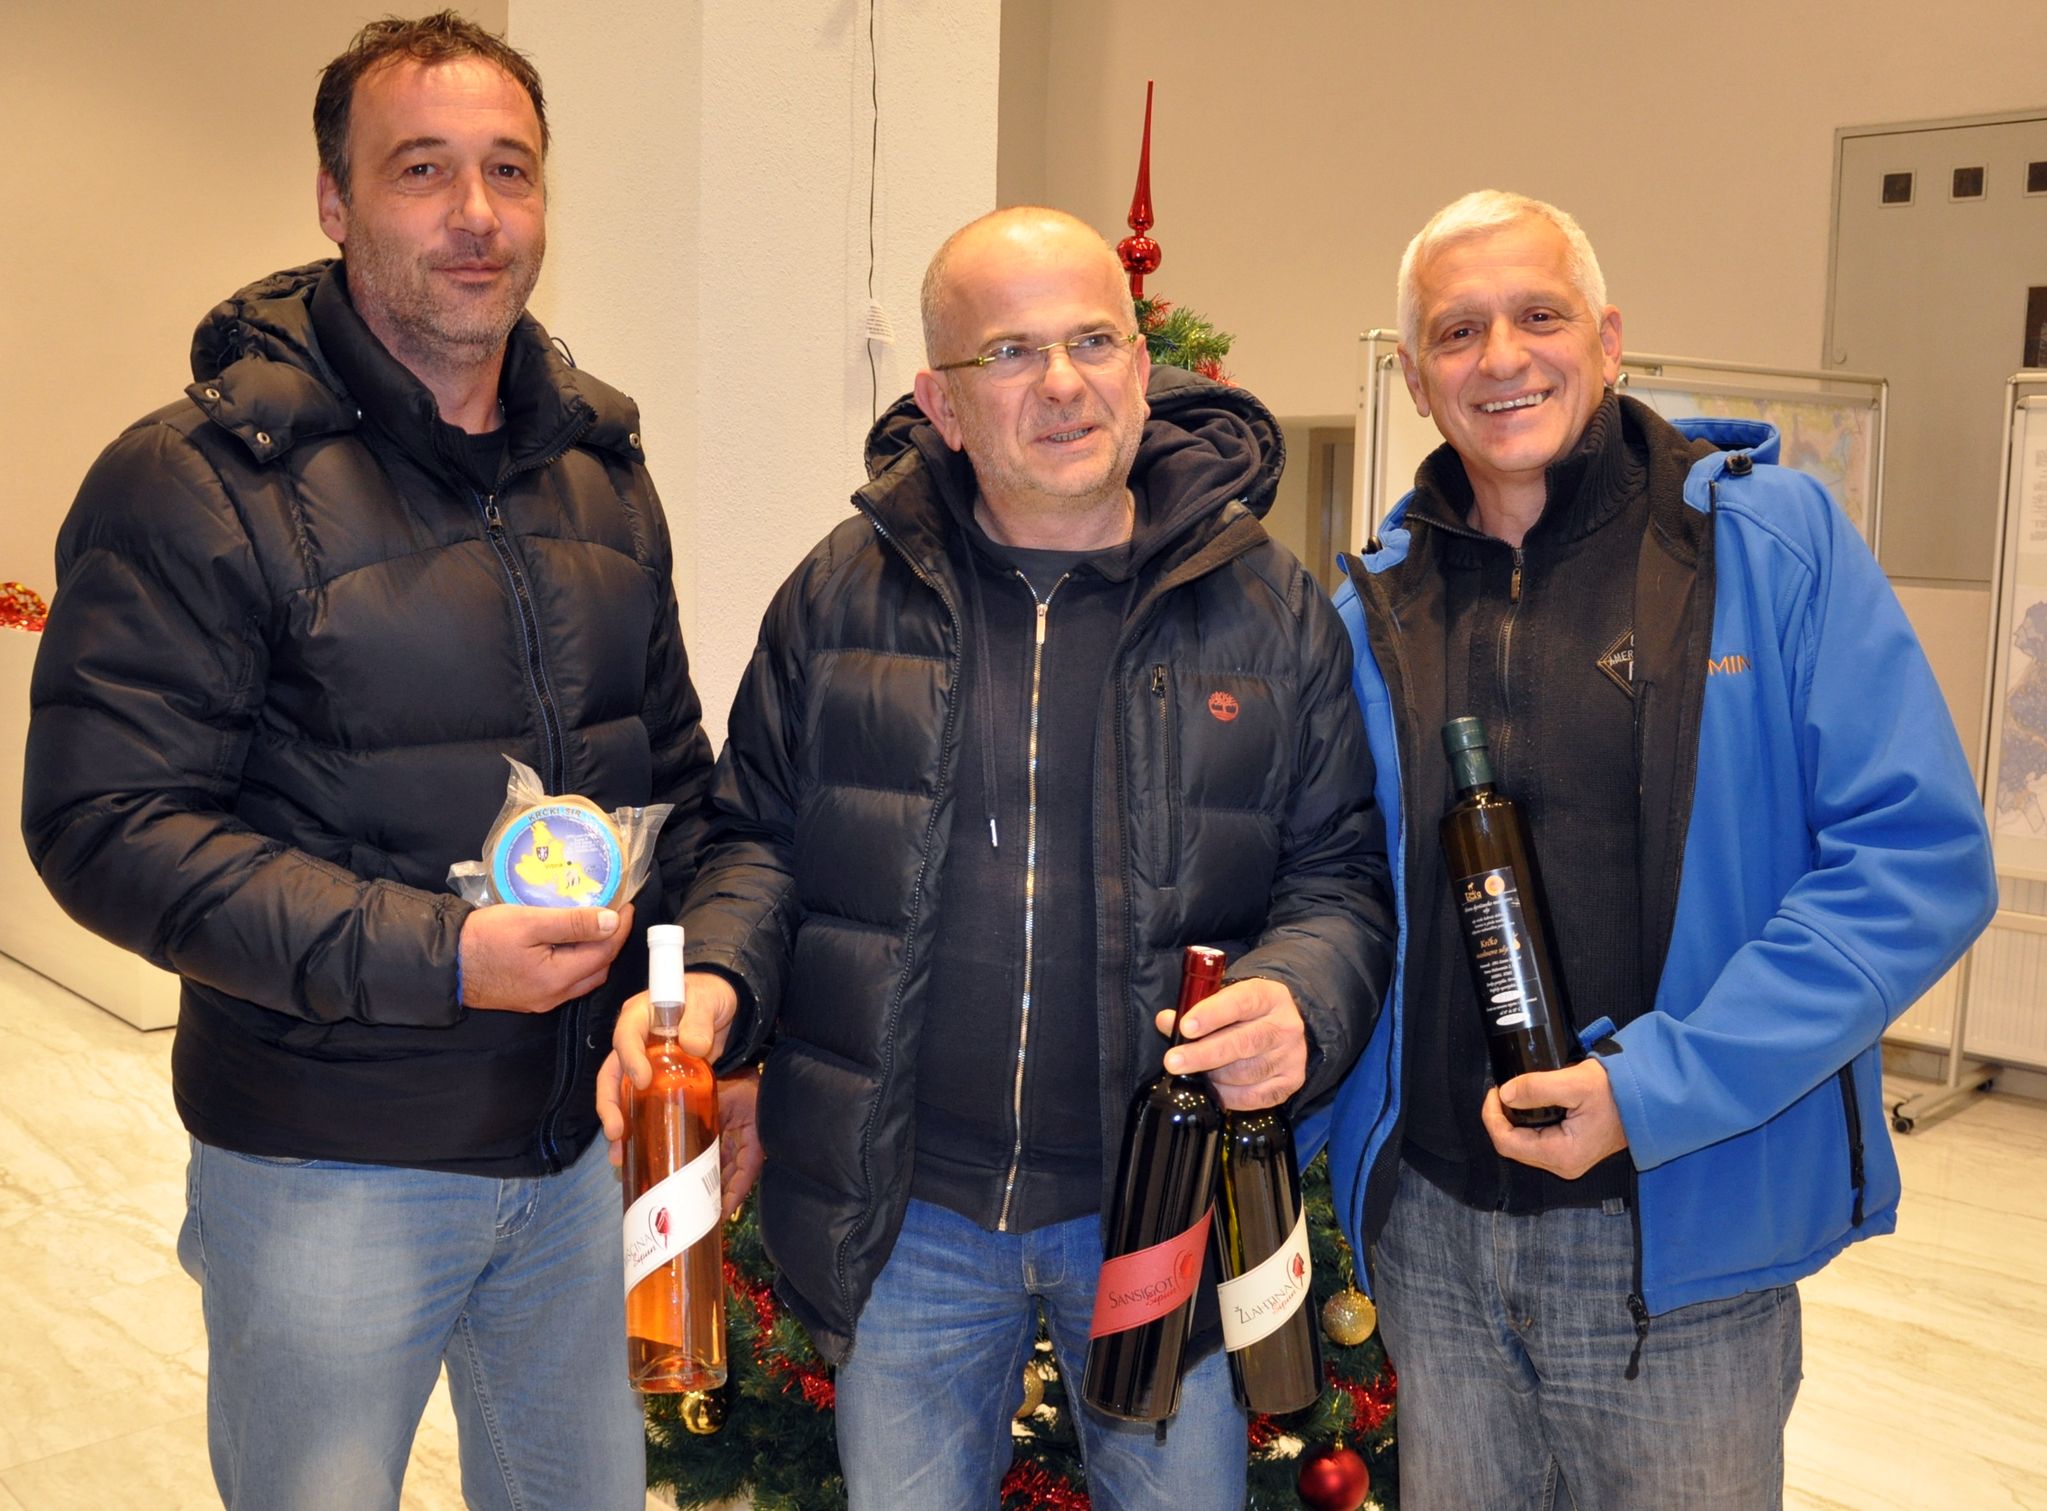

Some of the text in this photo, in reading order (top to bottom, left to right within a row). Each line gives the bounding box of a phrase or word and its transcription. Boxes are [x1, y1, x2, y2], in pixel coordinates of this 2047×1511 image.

[565, 807, 582, 817] SIR
[1109, 1275, 1173, 1309] SANSIGOT
[1234, 1283, 1293, 1324] ŽLAHTINA
